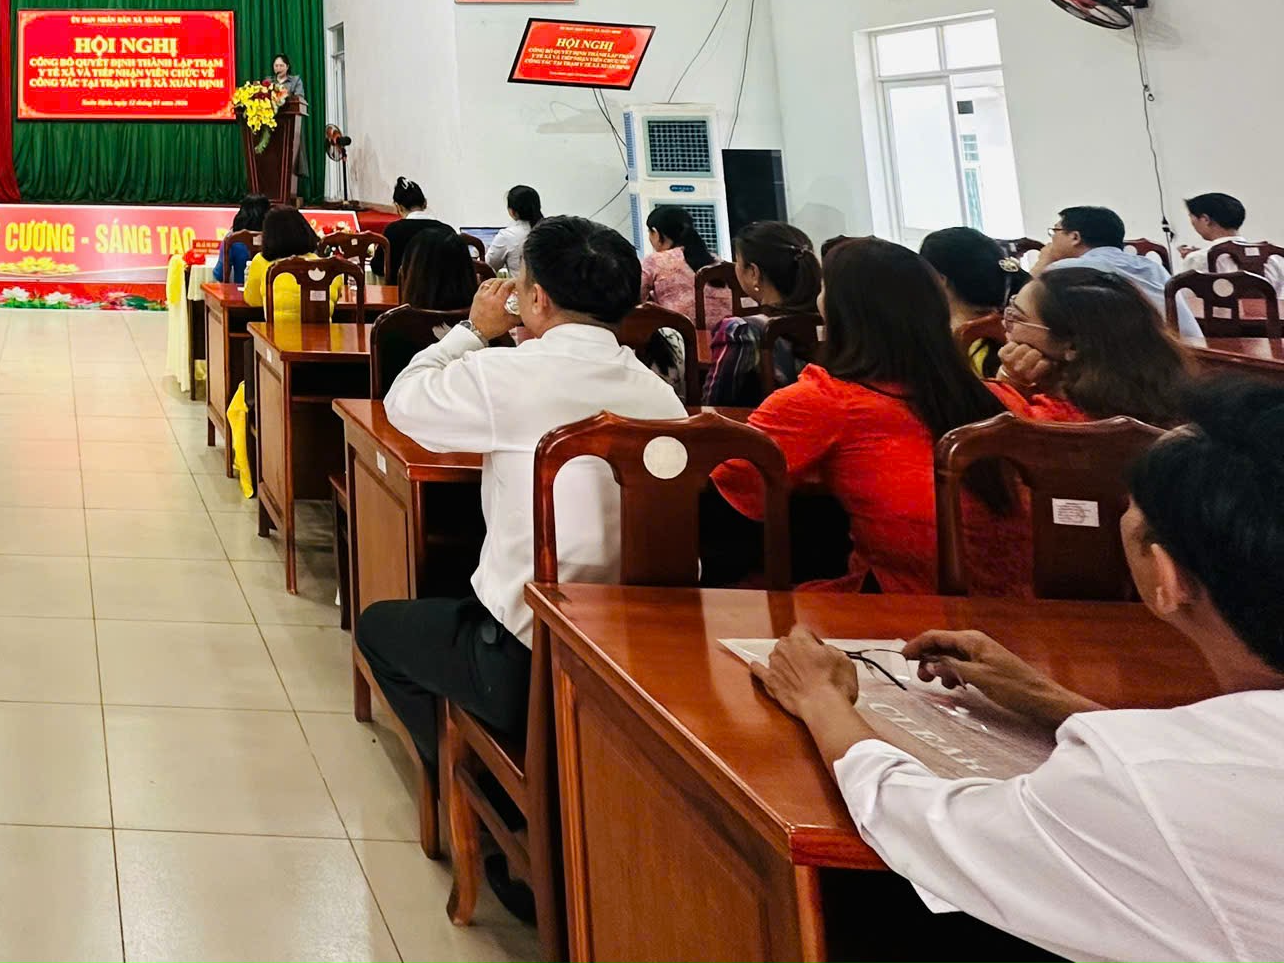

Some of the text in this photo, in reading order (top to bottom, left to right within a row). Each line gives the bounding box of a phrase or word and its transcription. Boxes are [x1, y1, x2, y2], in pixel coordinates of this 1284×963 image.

[74, 35, 178, 57] HỘI NGHỊ
[556, 37, 614, 52] HỘI NGHỊ
[29, 57, 59, 67] CÔNG
[75, 57, 109, 68] QUYẾT
[110, 58, 136, 69] ĐỊNH
[137, 57, 173, 68] THÀNH
[194, 58, 224, 69] TRẠM
[61, 68, 76, 78] XÃ
[76, 68, 91, 78] VÀ
[115, 68, 144, 79] NHẬN
[145, 68, 169, 78] VIÊN
[170, 68, 200, 78] CHỨC
[29, 77, 59, 88] CÔNG
[59, 77, 80, 88] TÁC
[81, 78, 99, 90] TẠI
[99, 78, 129, 90] TRẠM
[139, 77, 152, 88] TẾ
[153, 77, 168, 88] XÃ
[169, 77, 197, 88] XUÂN
[198, 78, 224, 90] ĐỊNH
[5, 220, 75, 253] CƯƠNG
[95, 218, 152, 254] SÁNG
[868, 702, 989, 772] CLEAR
